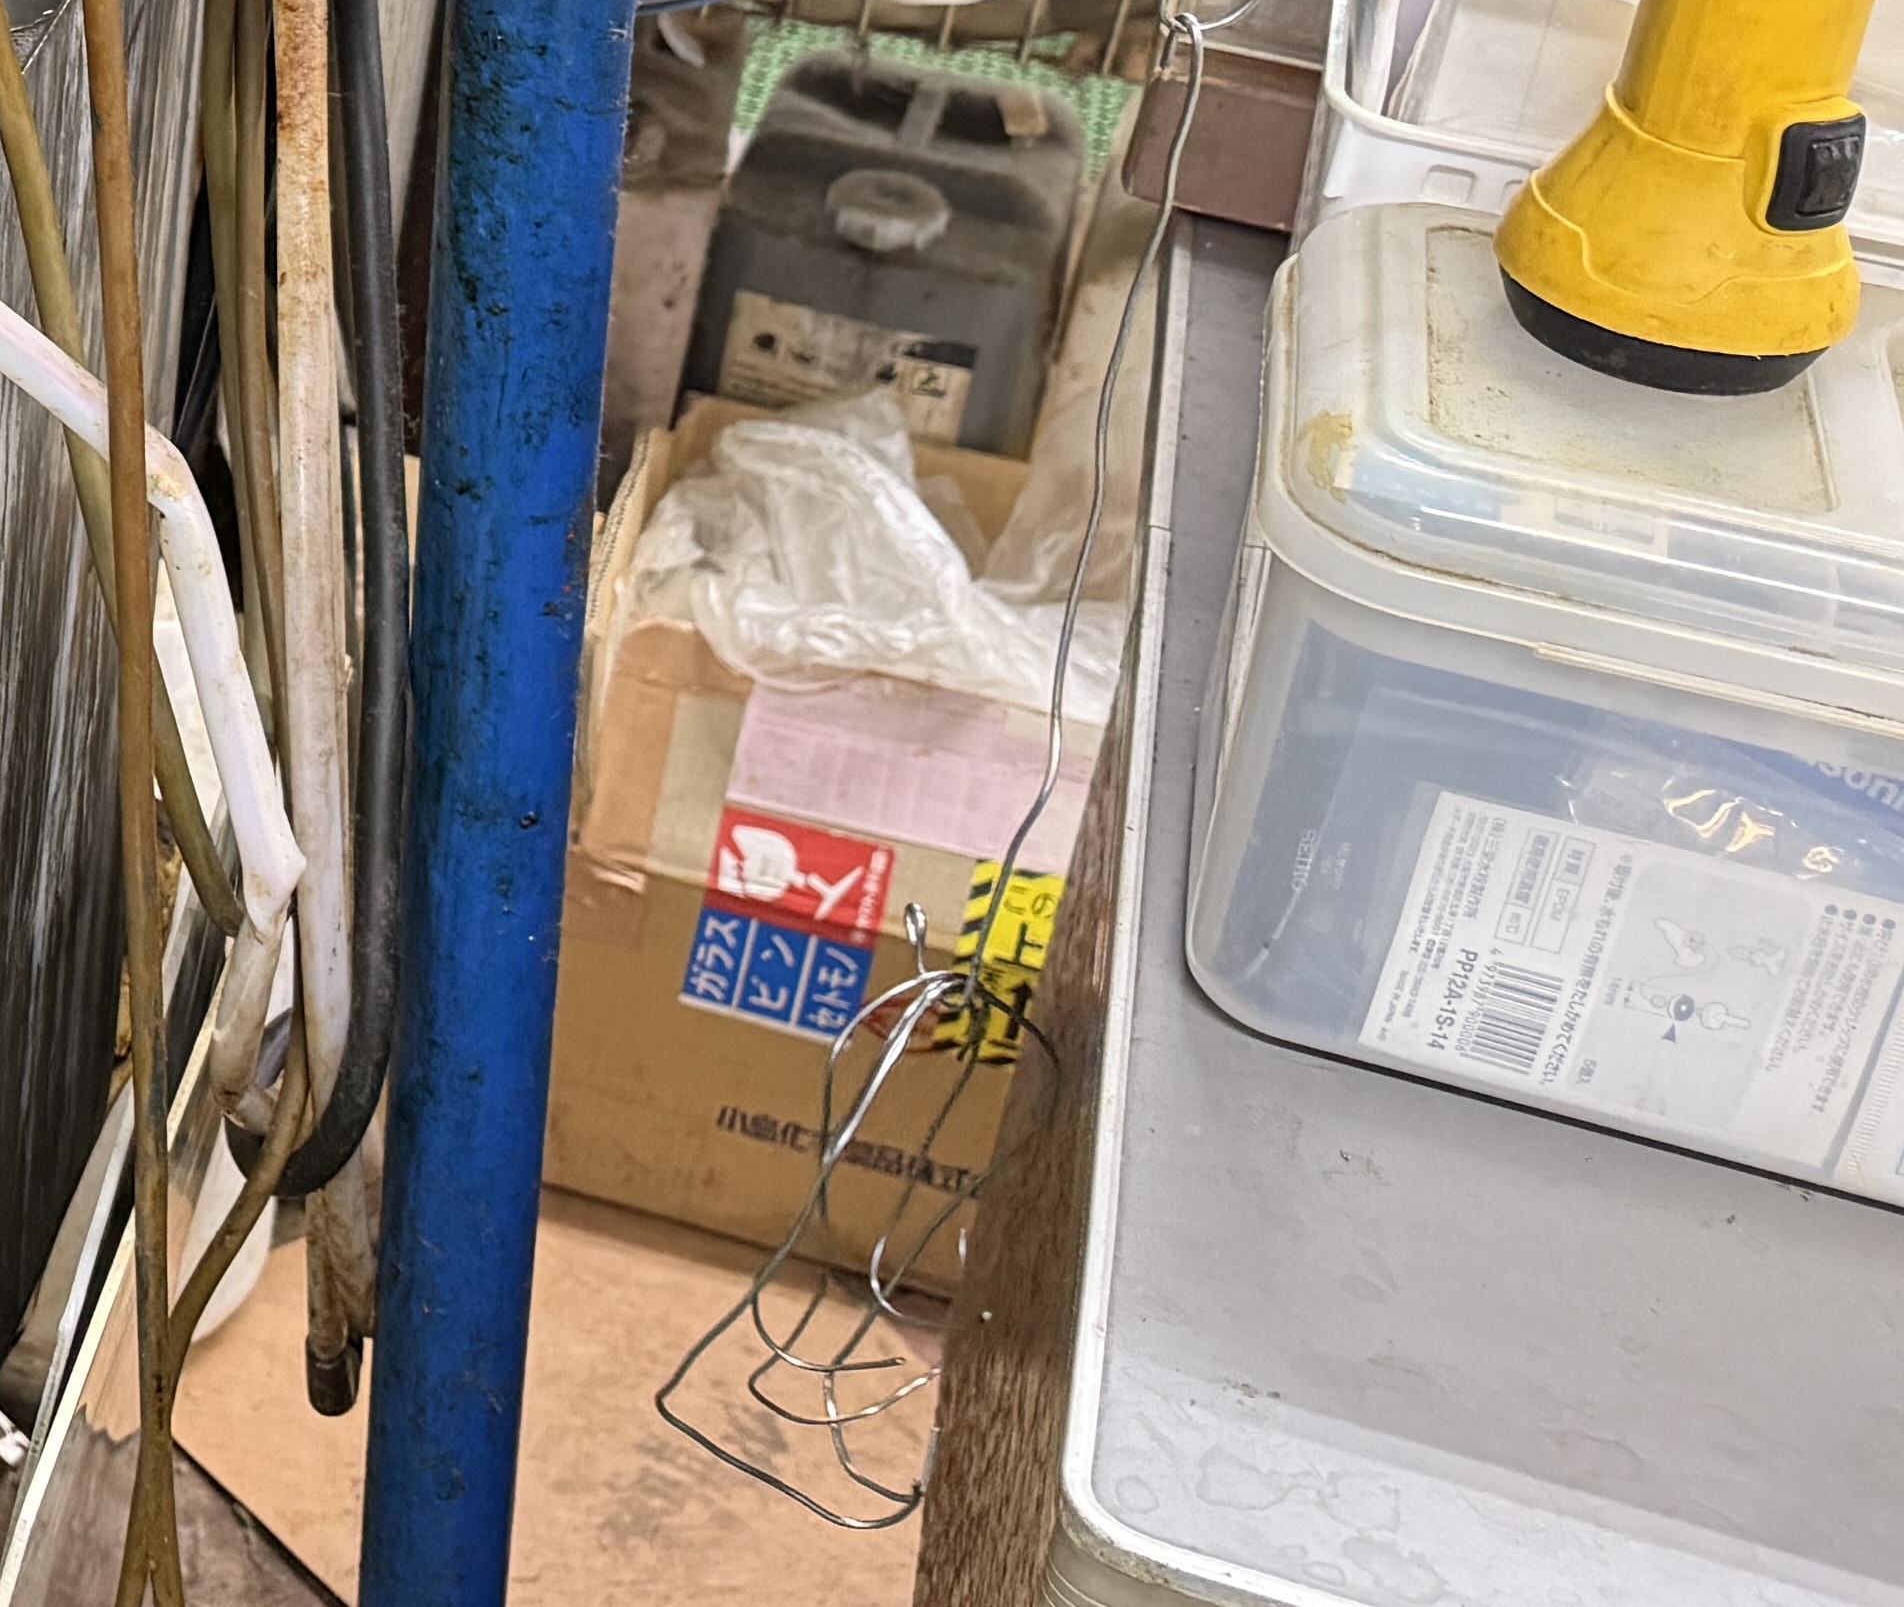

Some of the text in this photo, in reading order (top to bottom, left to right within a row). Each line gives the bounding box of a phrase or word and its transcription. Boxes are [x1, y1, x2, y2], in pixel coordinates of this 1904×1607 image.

[689, 916, 741, 1001] ガラス
[749, 934, 796, 1012] ビン
[807, 946, 860, 1029] セトモノ
[1428, 948, 1476, 1050] PP12A-1S-14
